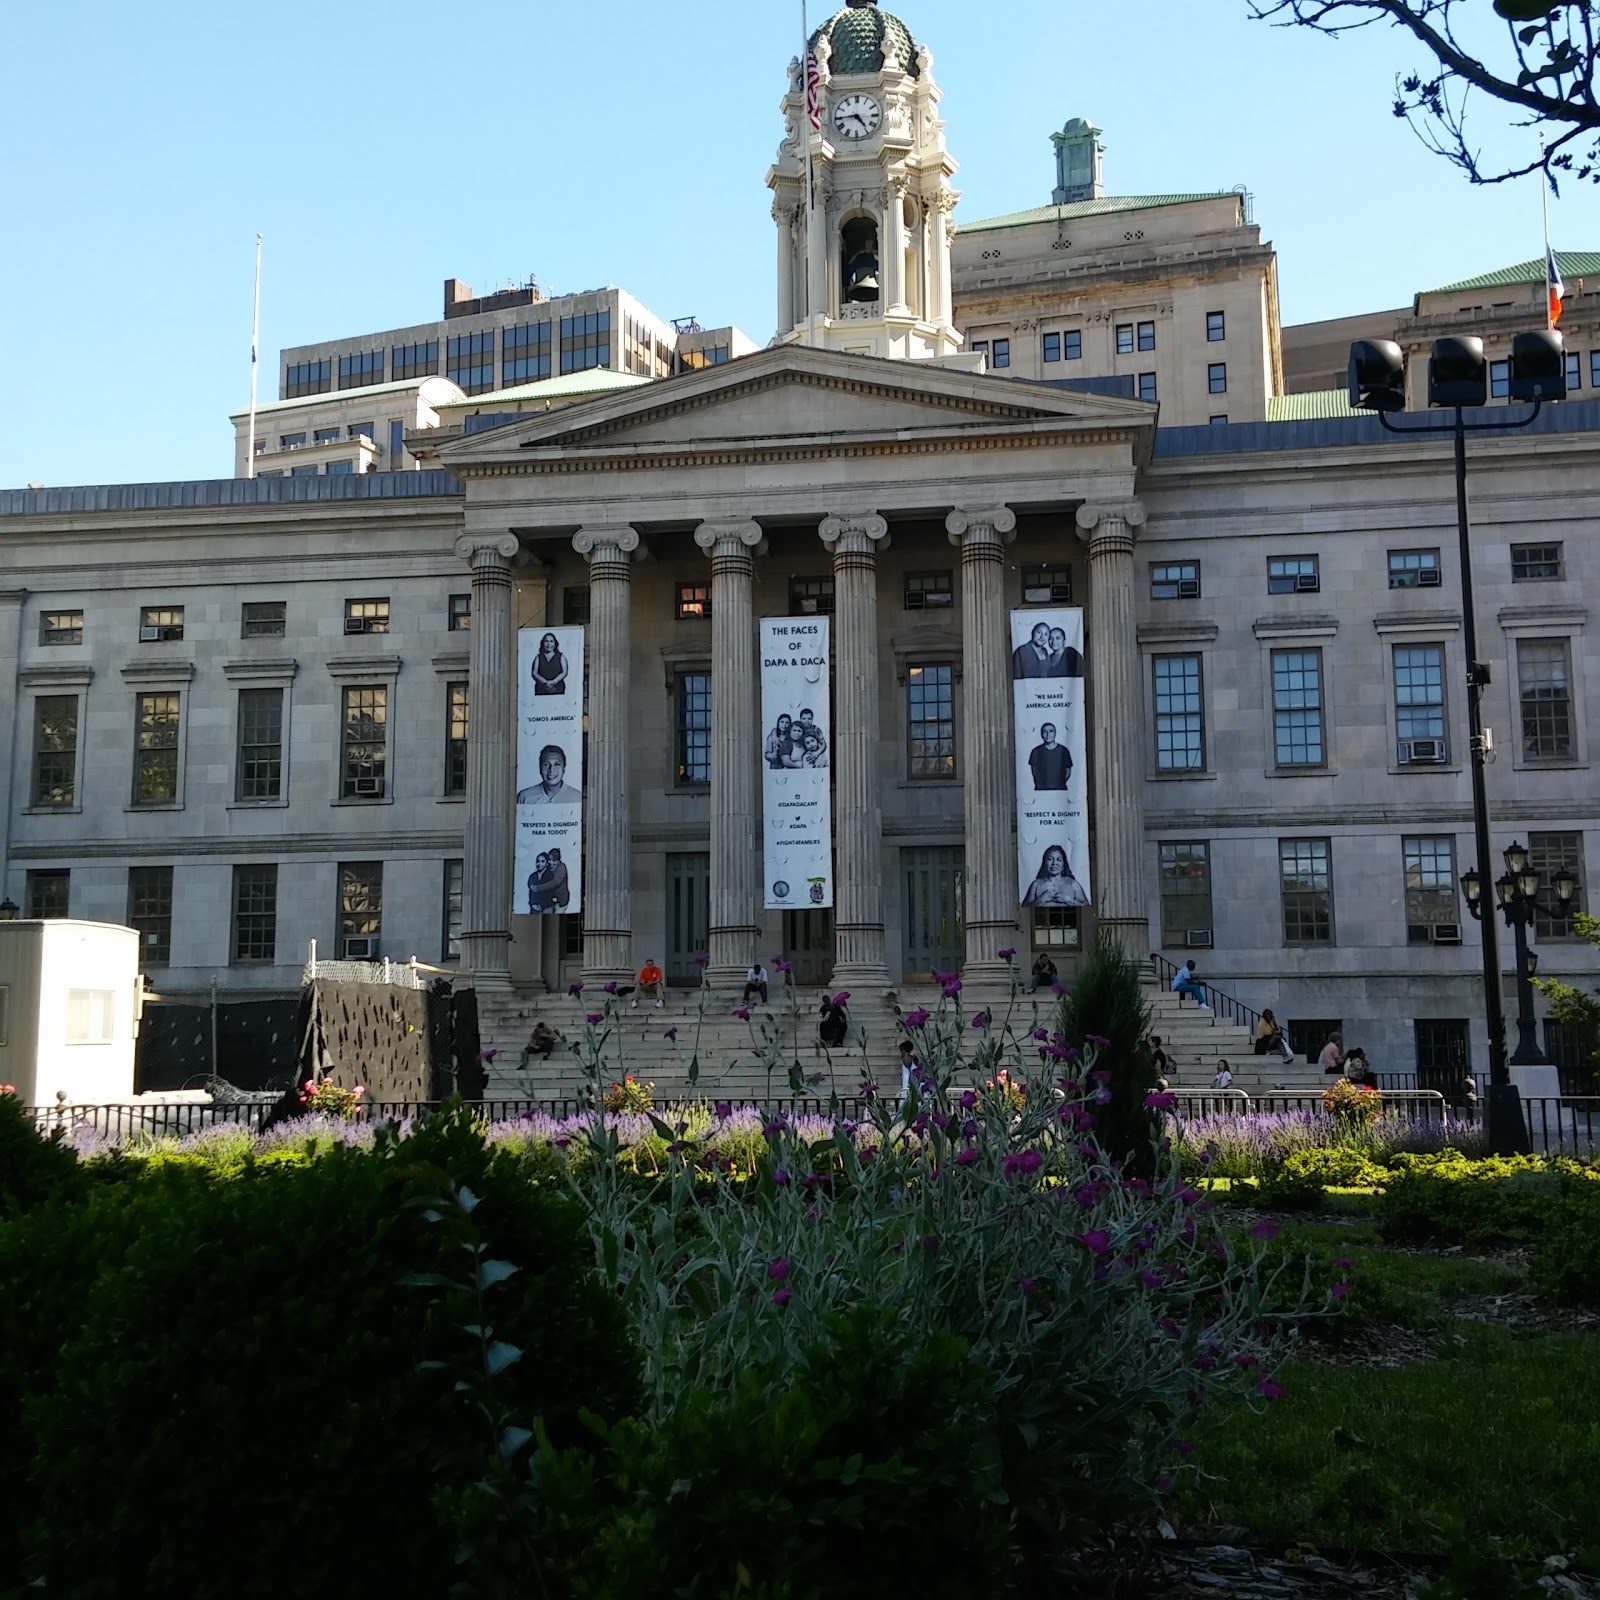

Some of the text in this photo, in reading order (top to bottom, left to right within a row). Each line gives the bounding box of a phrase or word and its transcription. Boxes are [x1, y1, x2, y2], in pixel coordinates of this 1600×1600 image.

[772, 626, 818, 635] THE FACES
[764, 657, 826, 667] DAPA & DACA
